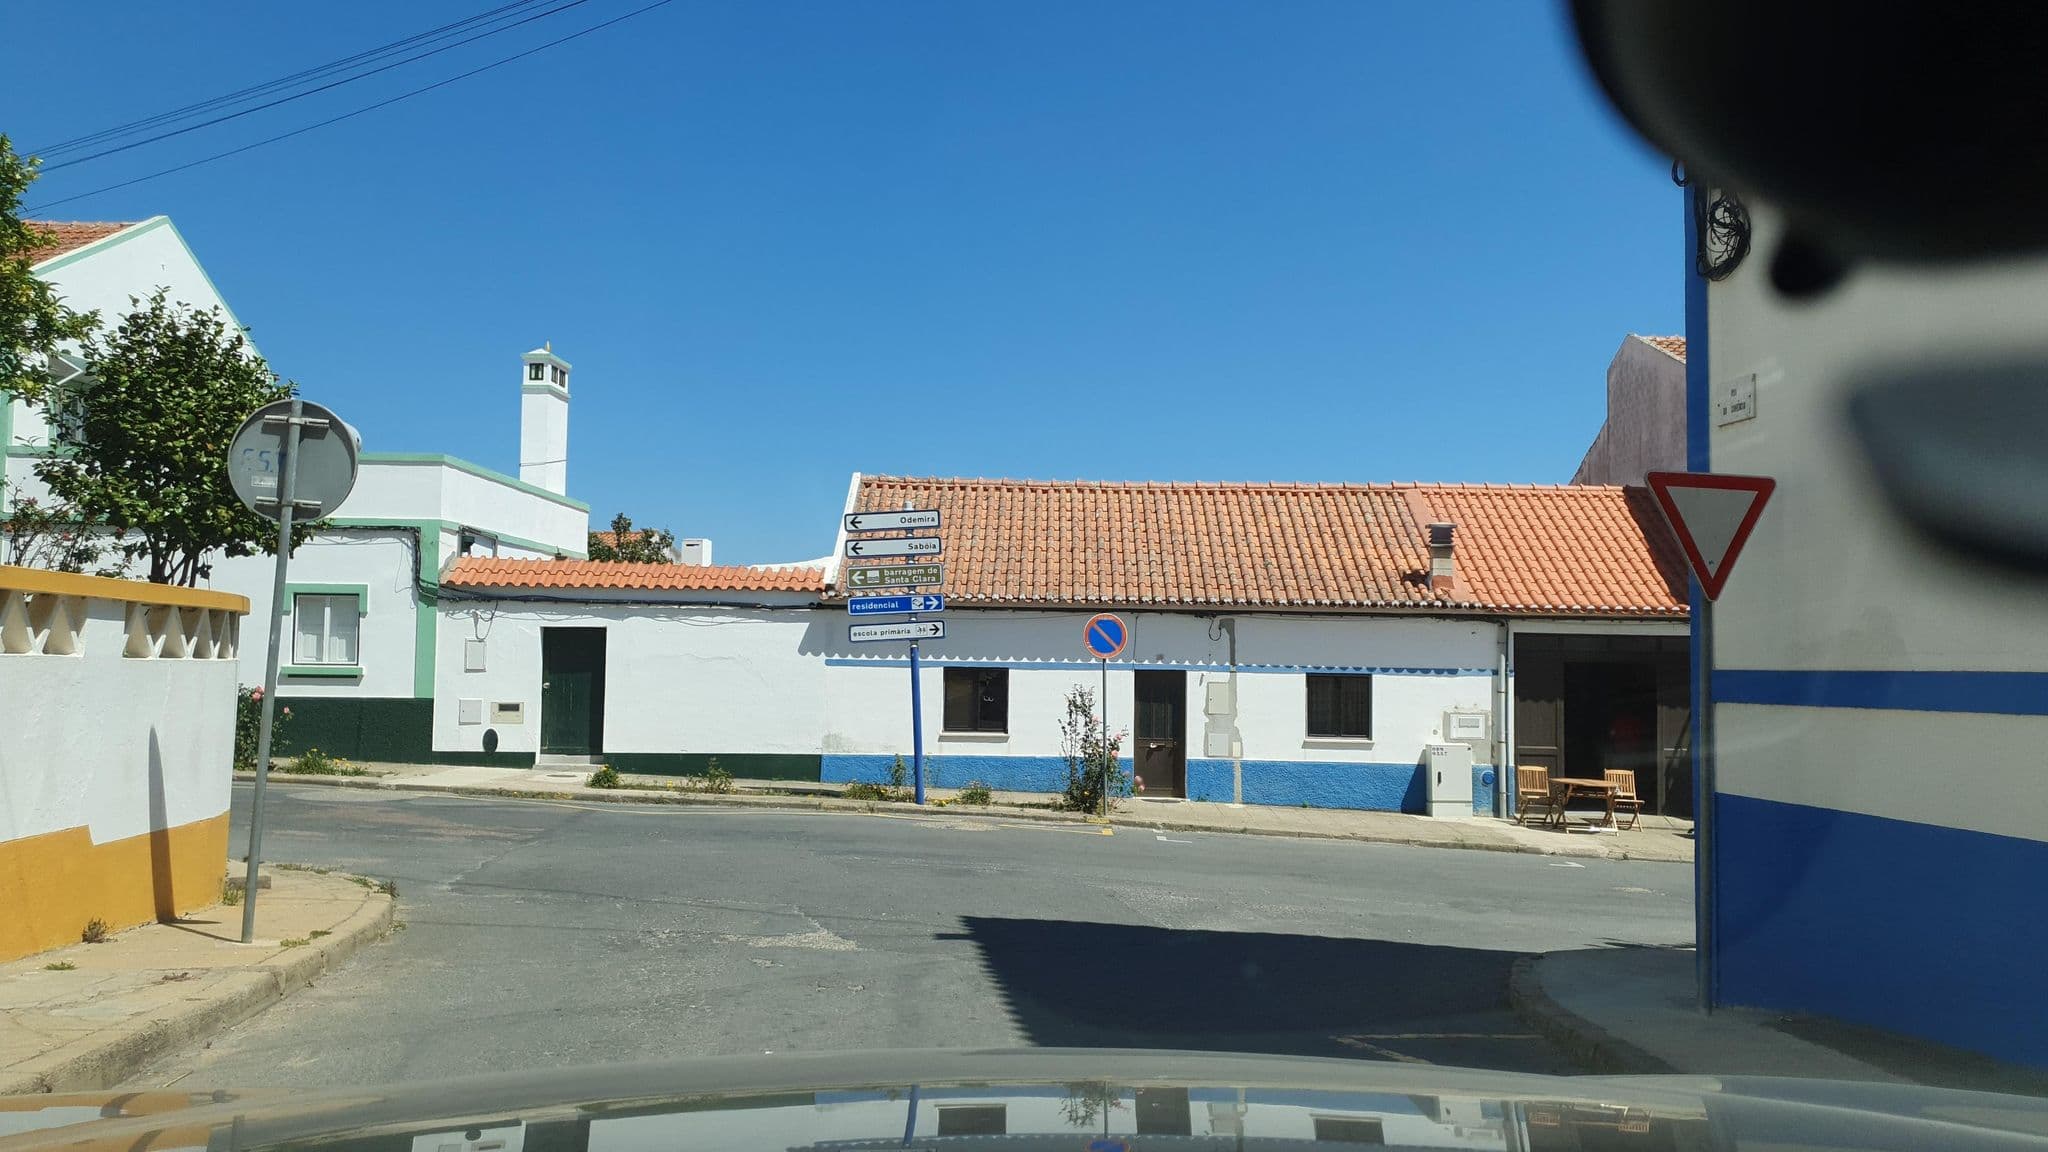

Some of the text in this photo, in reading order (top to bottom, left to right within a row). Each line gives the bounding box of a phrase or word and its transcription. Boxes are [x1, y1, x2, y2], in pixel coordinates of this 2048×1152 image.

[884, 568, 924, 576] barragem
[885, 575, 936, 584] Santa Clara
[852, 601, 899, 610] residencial
[853, 629, 877, 637] escola
